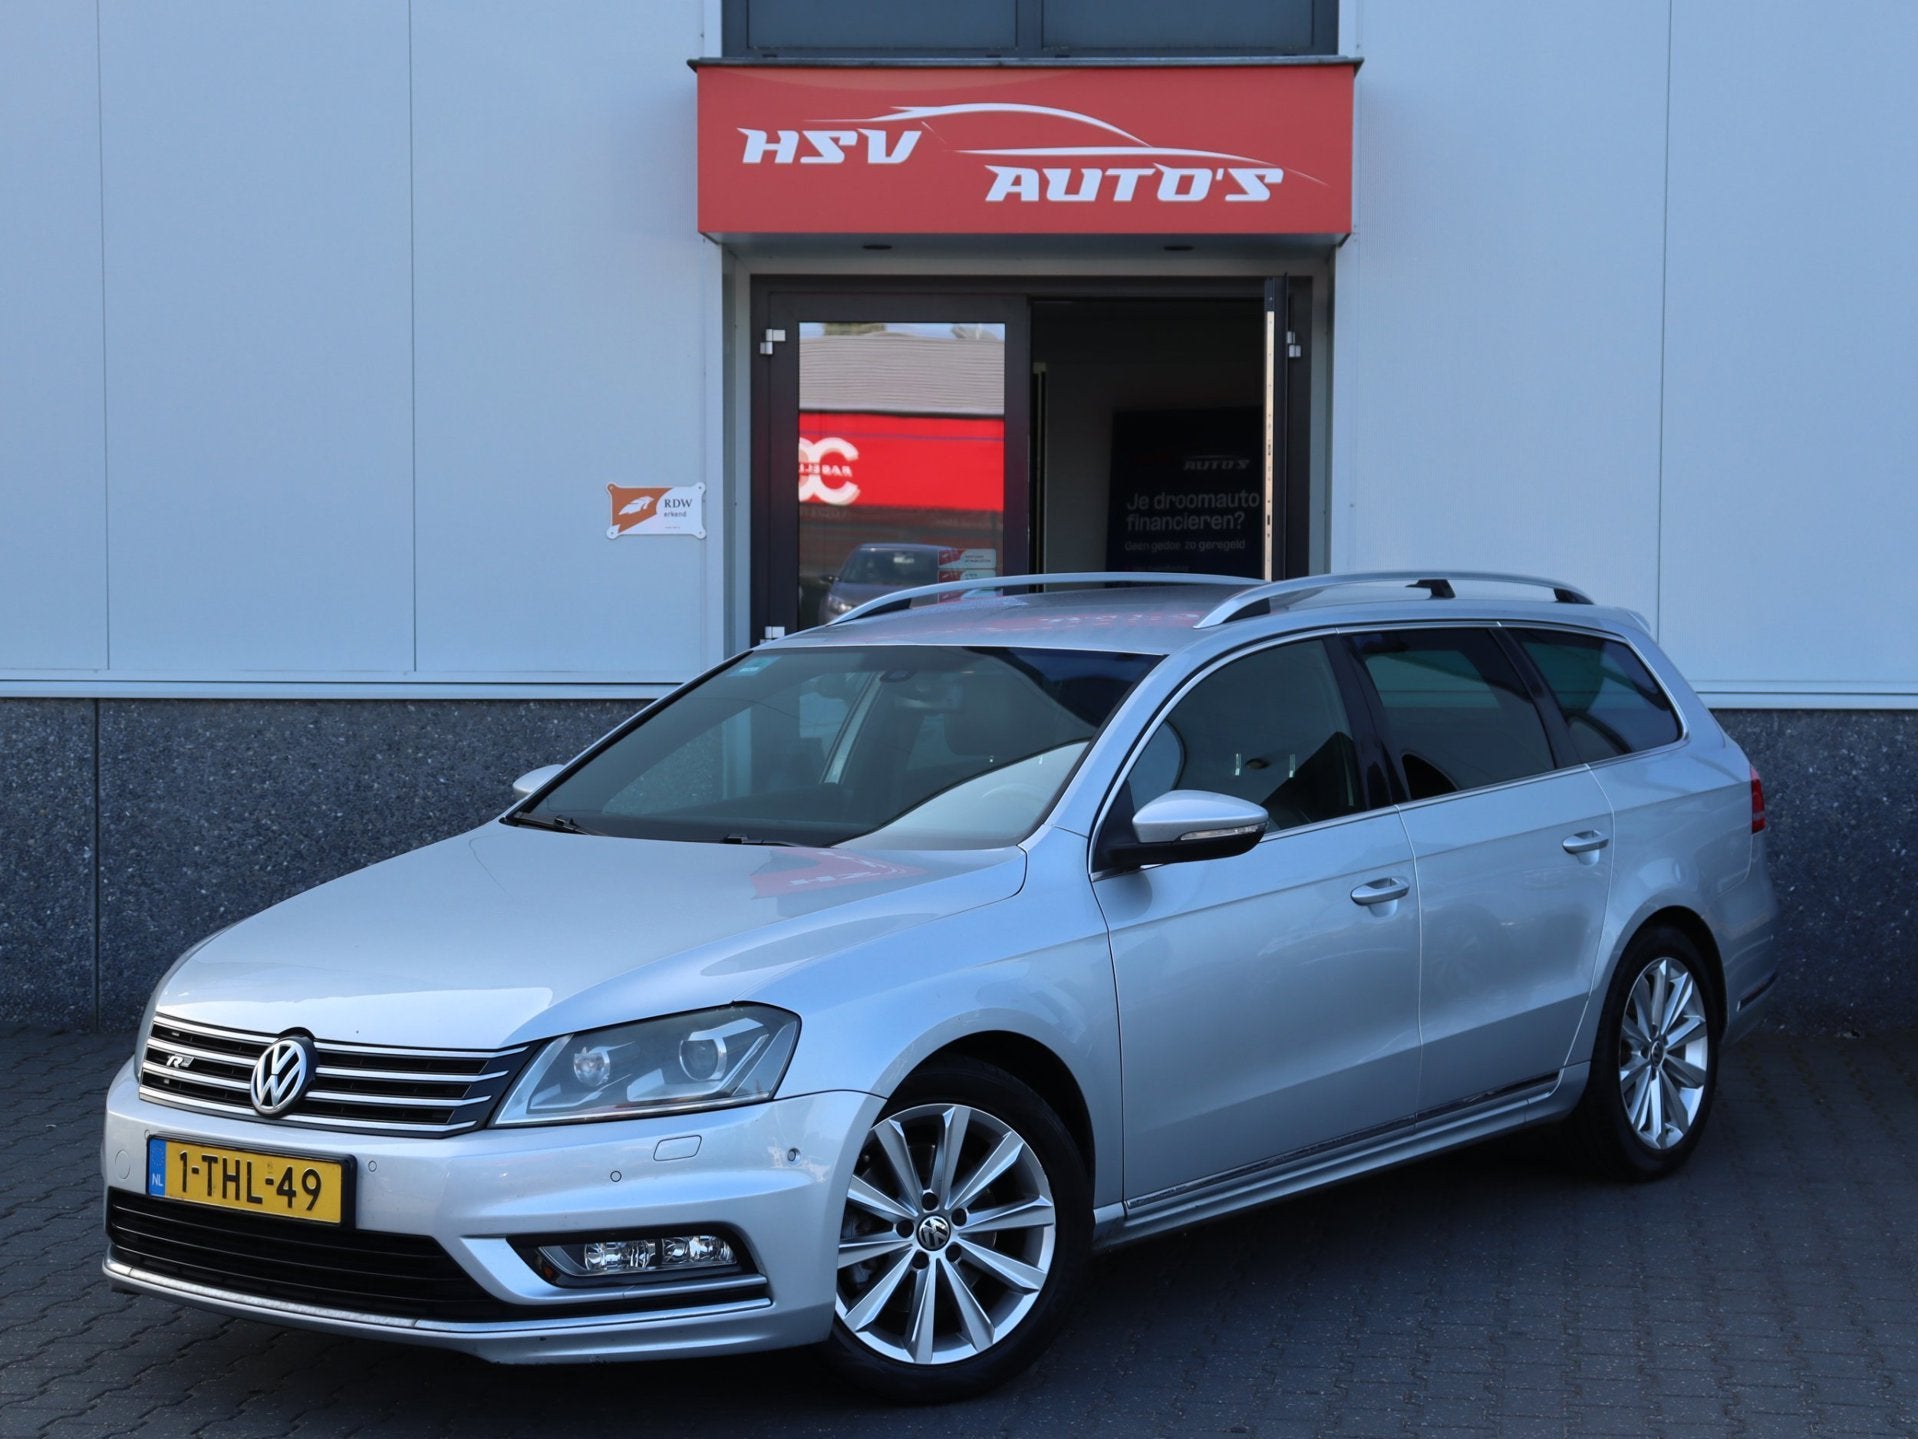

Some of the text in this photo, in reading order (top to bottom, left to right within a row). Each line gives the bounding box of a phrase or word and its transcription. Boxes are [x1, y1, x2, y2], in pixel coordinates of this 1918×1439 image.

[736, 127, 922, 164] HSV
[984, 163, 1284, 202] AUTO'S
[664, 499, 692, 508] RDW
[1127, 490, 1260, 510] Je droomauto
[1126, 511, 1245, 531] financieren?
[151, 1151, 322, 1212] NL 1-THL-49
